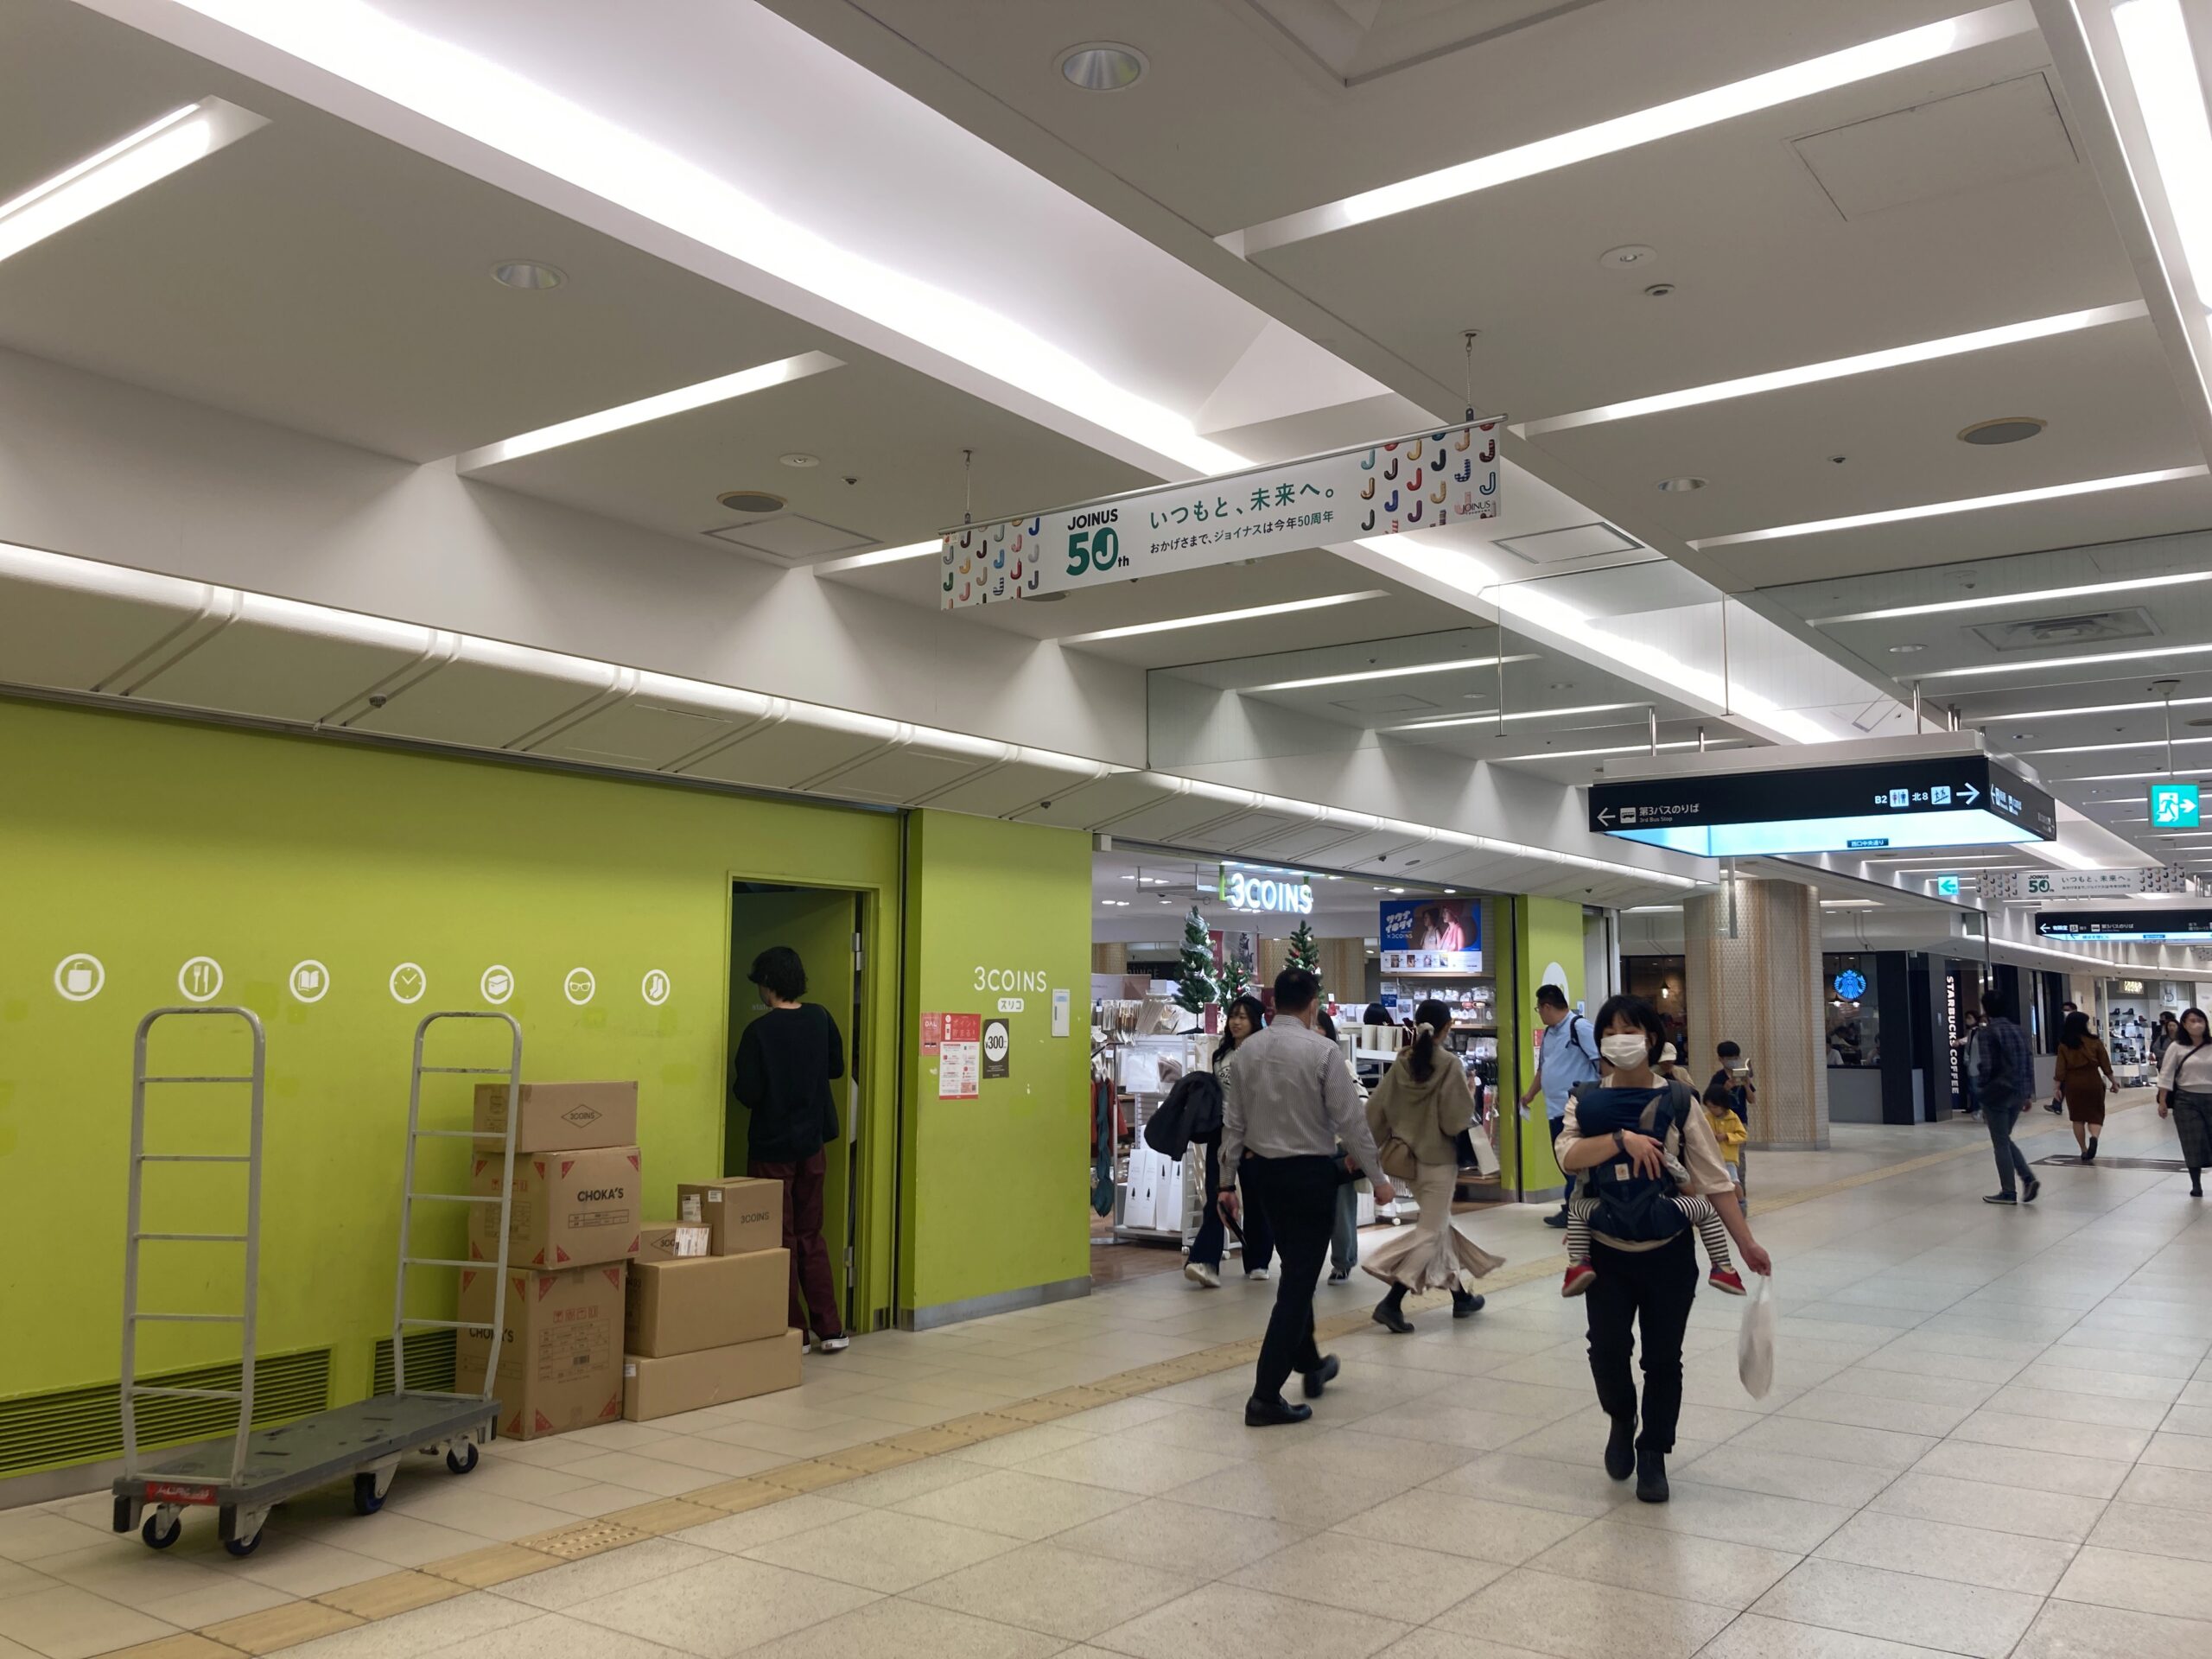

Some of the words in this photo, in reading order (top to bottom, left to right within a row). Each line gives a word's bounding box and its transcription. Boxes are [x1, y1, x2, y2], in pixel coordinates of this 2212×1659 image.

[1150, 482, 1334, 530] いつもと、未来へ。
[1462, 500, 1491, 514] JOINUS
[1067, 508, 1119, 531] JOINUS
[1150, 510, 1334, 554] おかげさまで、ジョイナスは今年50周年
[1065, 526, 1119, 576] 50
[1117, 555, 1129, 568] th
[1874, 795, 1888, 804] B2
[1911, 791, 1929, 802] 北8
[1638, 803, 1700, 817] 第3バスのりば
[2062, 874, 2131, 883] いつもと、未来へ。
[1230, 872, 1313, 914] 3COINS
[2028, 880, 2050, 893] 50
[974, 965, 1047, 993] 3COINS
[1000, 1000, 1021, 1010] スリコ
[1946, 976, 1957, 1047] STARBUCKS
[1949, 1049, 1960, 1095] COFFEE
[569, 1111, 595, 1121] 3COINS
[577, 1187, 625, 1202] CHOKA'S
[741, 1211, 771, 1224] 3COINS
[468, 1327, 514, 1343] CHO'S
